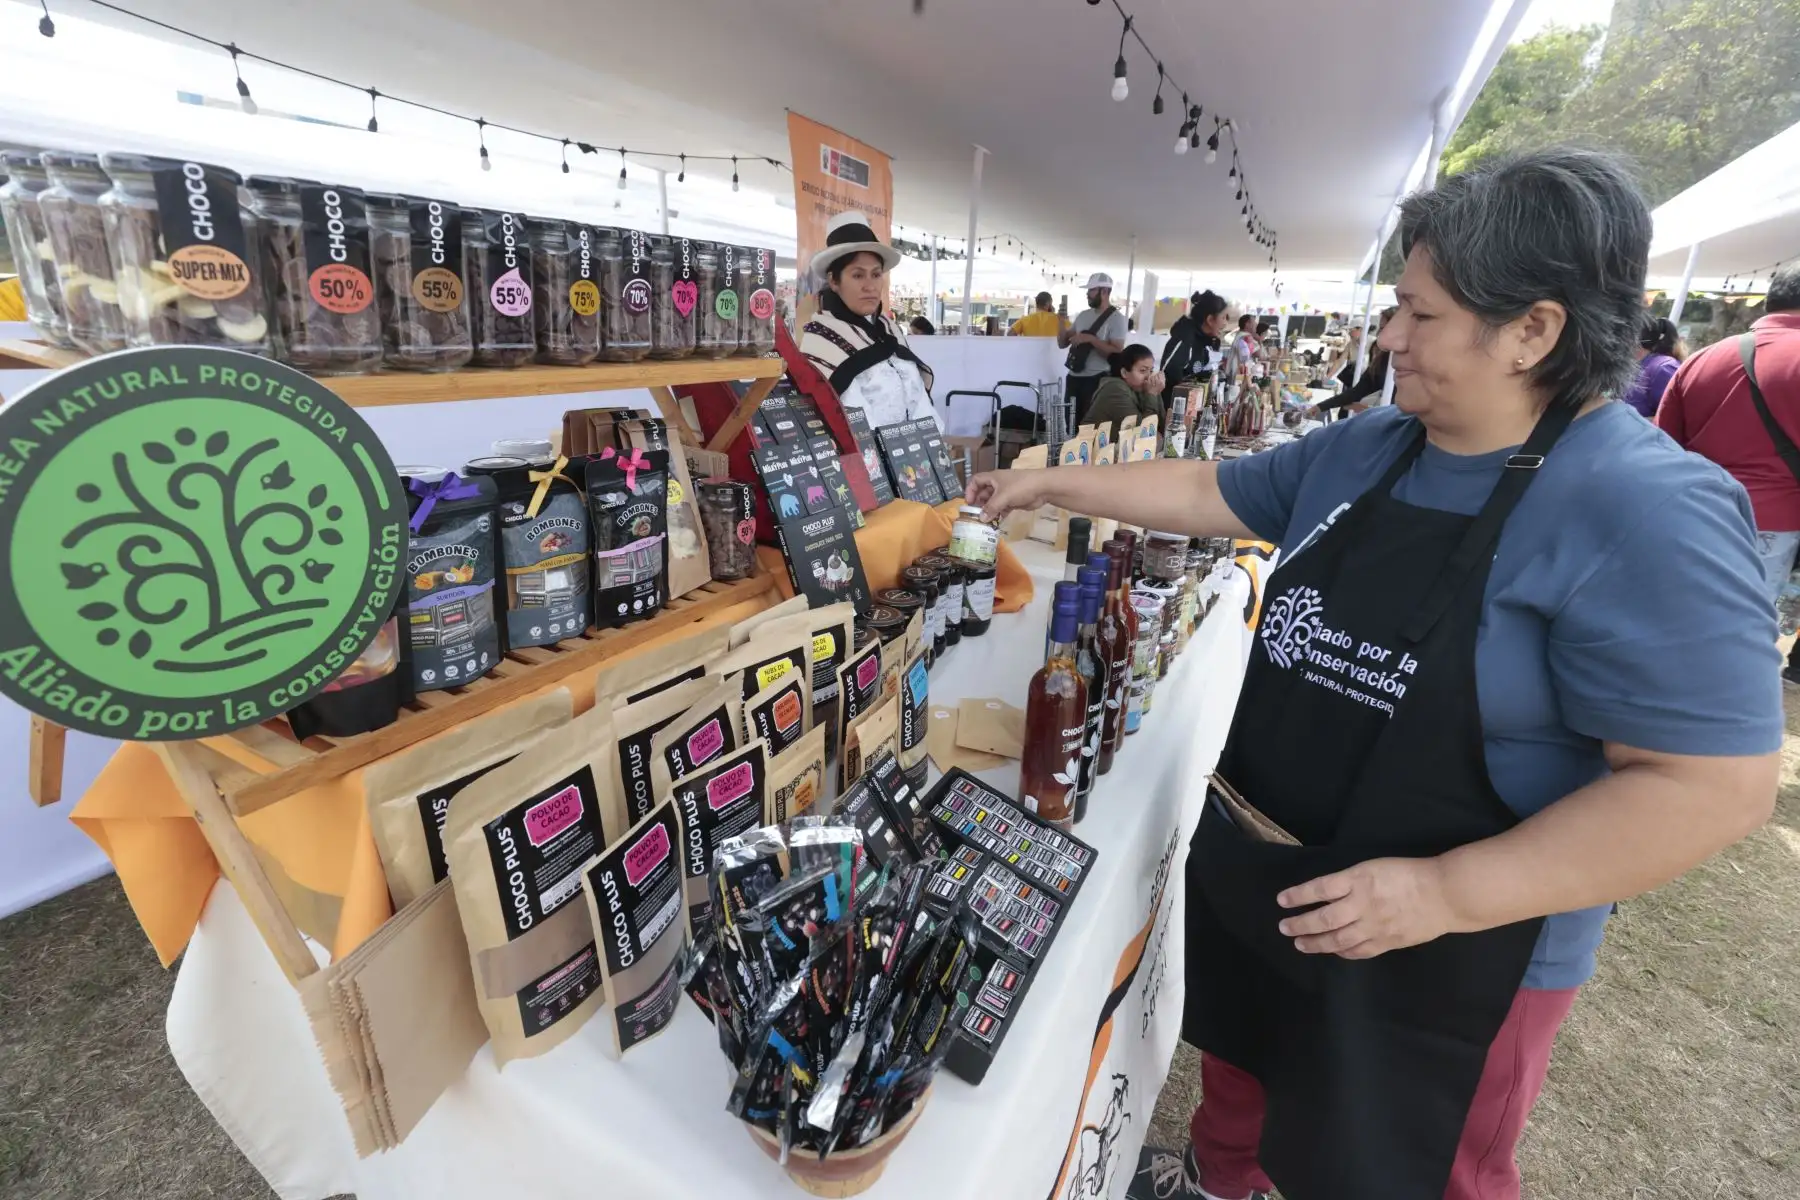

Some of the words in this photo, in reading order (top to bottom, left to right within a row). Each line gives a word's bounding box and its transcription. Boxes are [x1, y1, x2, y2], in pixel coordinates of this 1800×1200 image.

[182, 163, 215, 241] CHOCO
[323, 190, 347, 262] CHOCO
[428, 202, 445, 264] CHOCO
[502, 213, 517, 268] CHOCO
[631, 230, 640, 274] CHOCO
[580, 230, 590, 278] CHOCO
[172, 260, 246, 282] SUPER-MIX
[320, 278, 364, 300] 50%
[422, 281, 456, 300] 55%
[496, 287, 528, 306] 55%
[574, 292, 595, 307] 75%
[630, 290, 648, 304] 70%
[676, 290, 694, 304] 70%
[720, 298, 736, 312] 70%
[31, 365, 188, 436] NATURAL
[199, 365, 348, 443] PROTEGIDA
[616, 502, 658, 526] BOMBONES
[803, 521, 822, 532] CHOCO
[822, 516, 835, 526] PLUS
[525, 517, 582, 542] BOMBONES
[407, 544, 478, 574] BOMBONES
[0, 644, 130, 727] Aliado
[135, 708, 213, 738] por
[222, 698, 260, 725] la
[269, 522, 401, 706] conservación
[1312, 622, 1352, 650] iado
[1356, 641, 1392, 664] por
[1397, 652, 1418, 676] la
[778, 662, 785, 670] DE
[1306, 644, 1406, 700] nservación
[846, 674, 856, 702] PLUS
[1304, 670, 1344, 694] NATURAL
[690, 728, 707, 746] POLVO
[707, 722, 716, 734] DE
[758, 712, 770, 737] PLUS
[696, 734, 715, 751] CACAO
[628, 744, 642, 778] PLUS
[876, 762, 889, 778] CHOCO
[888, 756, 897, 768] PLUS
[712, 772, 737, 788] POLVO
[737, 766, 747, 776] DE
[718, 778, 742, 796] CACAO
[872, 776, 882, 792] CHOCO
[532, 800, 561, 822] POLVO
[562, 792, 573, 804] DE
[634, 780, 649, 822] HOCO
[683, 791, 700, 826] PLUS
[848, 796, 862, 812] CHOCO
[540, 806, 570, 828] CACAO
[498, 826, 520, 870] PLUS
[629, 840, 651, 864] POLVO
[651, 830, 660, 842] DE
[636, 844, 659, 868] CACAO
[690, 829, 704, 875] CHOCO
[509, 871, 533, 930] CHOCO
[602, 870, 622, 912] PLUS
[614, 911, 634, 967] CHOCO
[852, 1000, 862, 1022] PLUS
